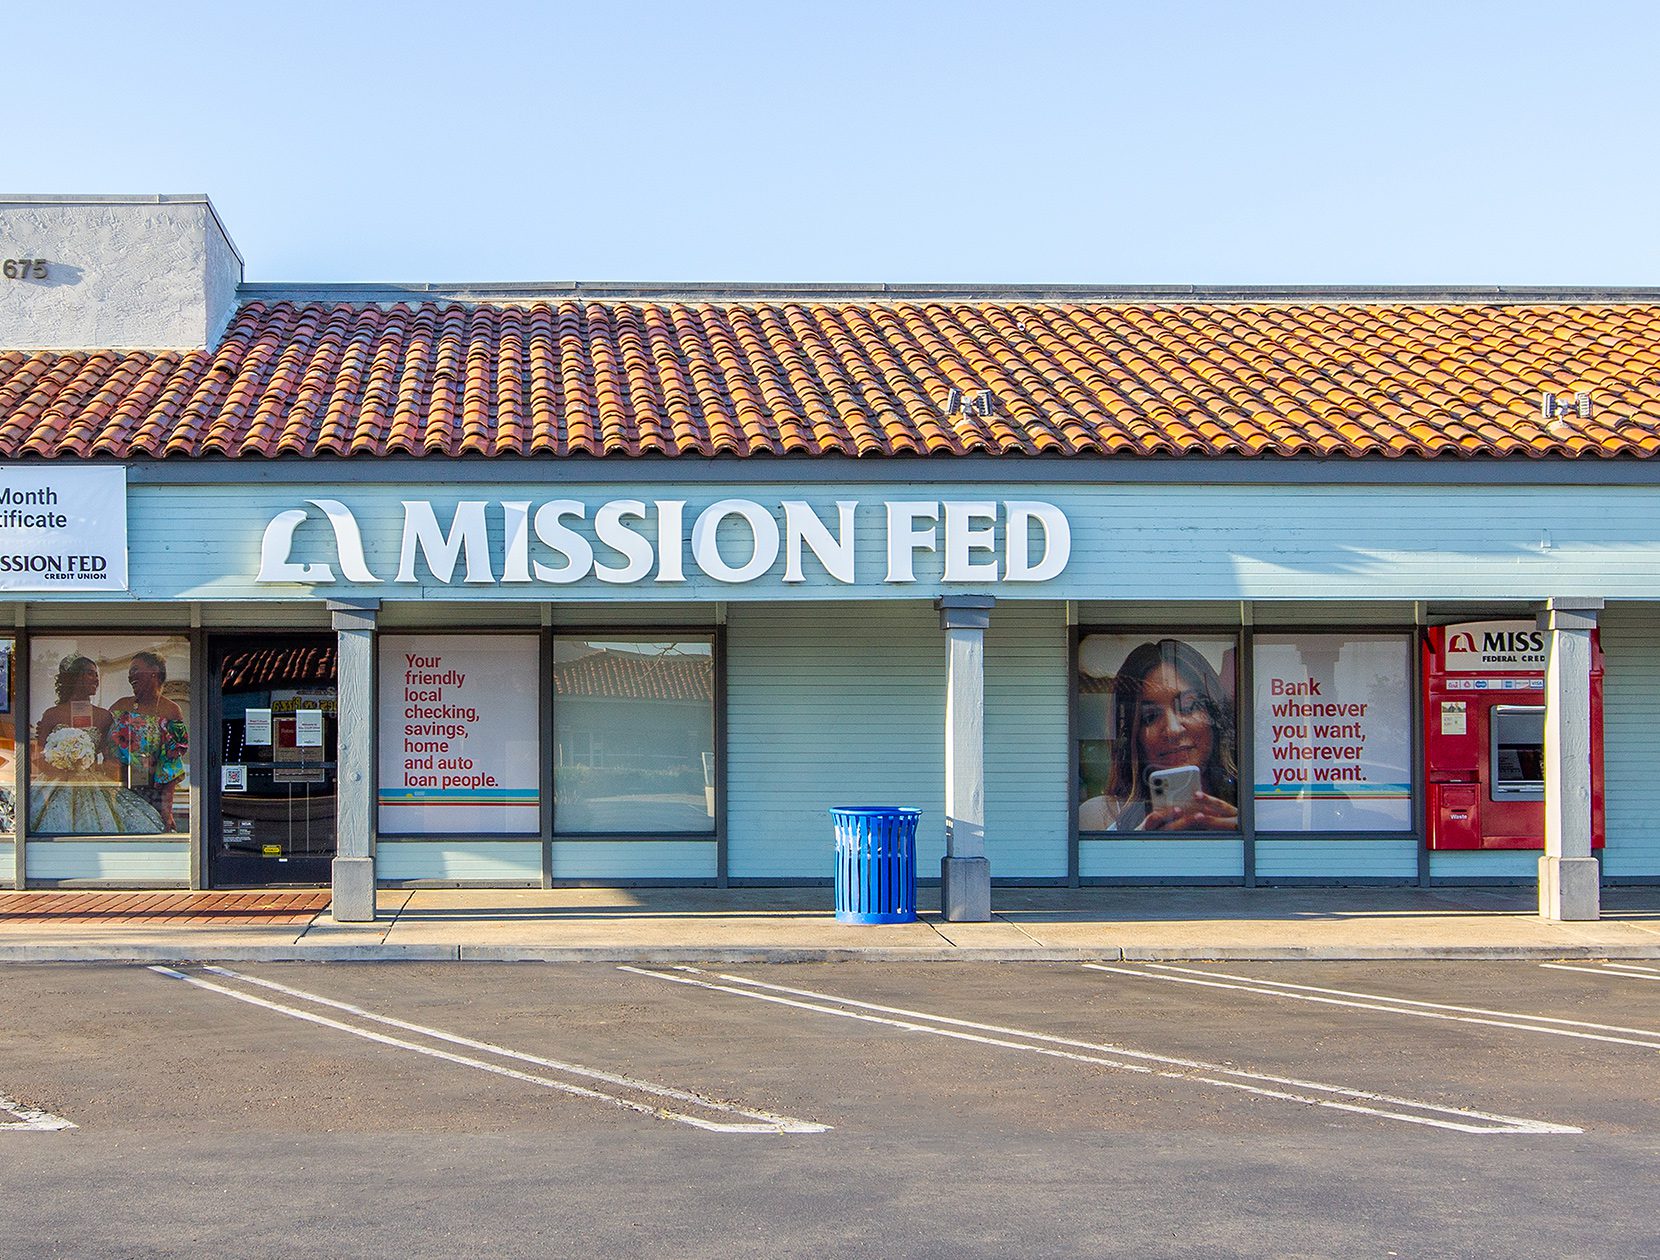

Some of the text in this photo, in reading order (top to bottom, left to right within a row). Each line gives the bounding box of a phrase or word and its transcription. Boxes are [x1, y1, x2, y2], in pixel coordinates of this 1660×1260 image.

[3, 259, 48, 279] 675
[394, 499, 1071, 584] MISSION FED
[68, 555, 107, 572] FED
[1482, 631, 1544, 652] MISS
[405, 654, 441, 668] Your
[405, 670, 466, 688] friendly
[1271, 677, 1321, 695] Bank
[404, 687, 442, 702] local
[404, 704, 480, 722] checking,
[1272, 699, 1367, 717] whenever
[404, 722, 469, 739] savings,
[1272, 722, 1366, 743] you want,
[404, 738, 449, 753] home
[1272, 742, 1363, 760] wherever
[404, 755, 473, 770] and auto
[404, 772, 499, 790] loan people.
[1272, 765, 1367, 786] you want.
